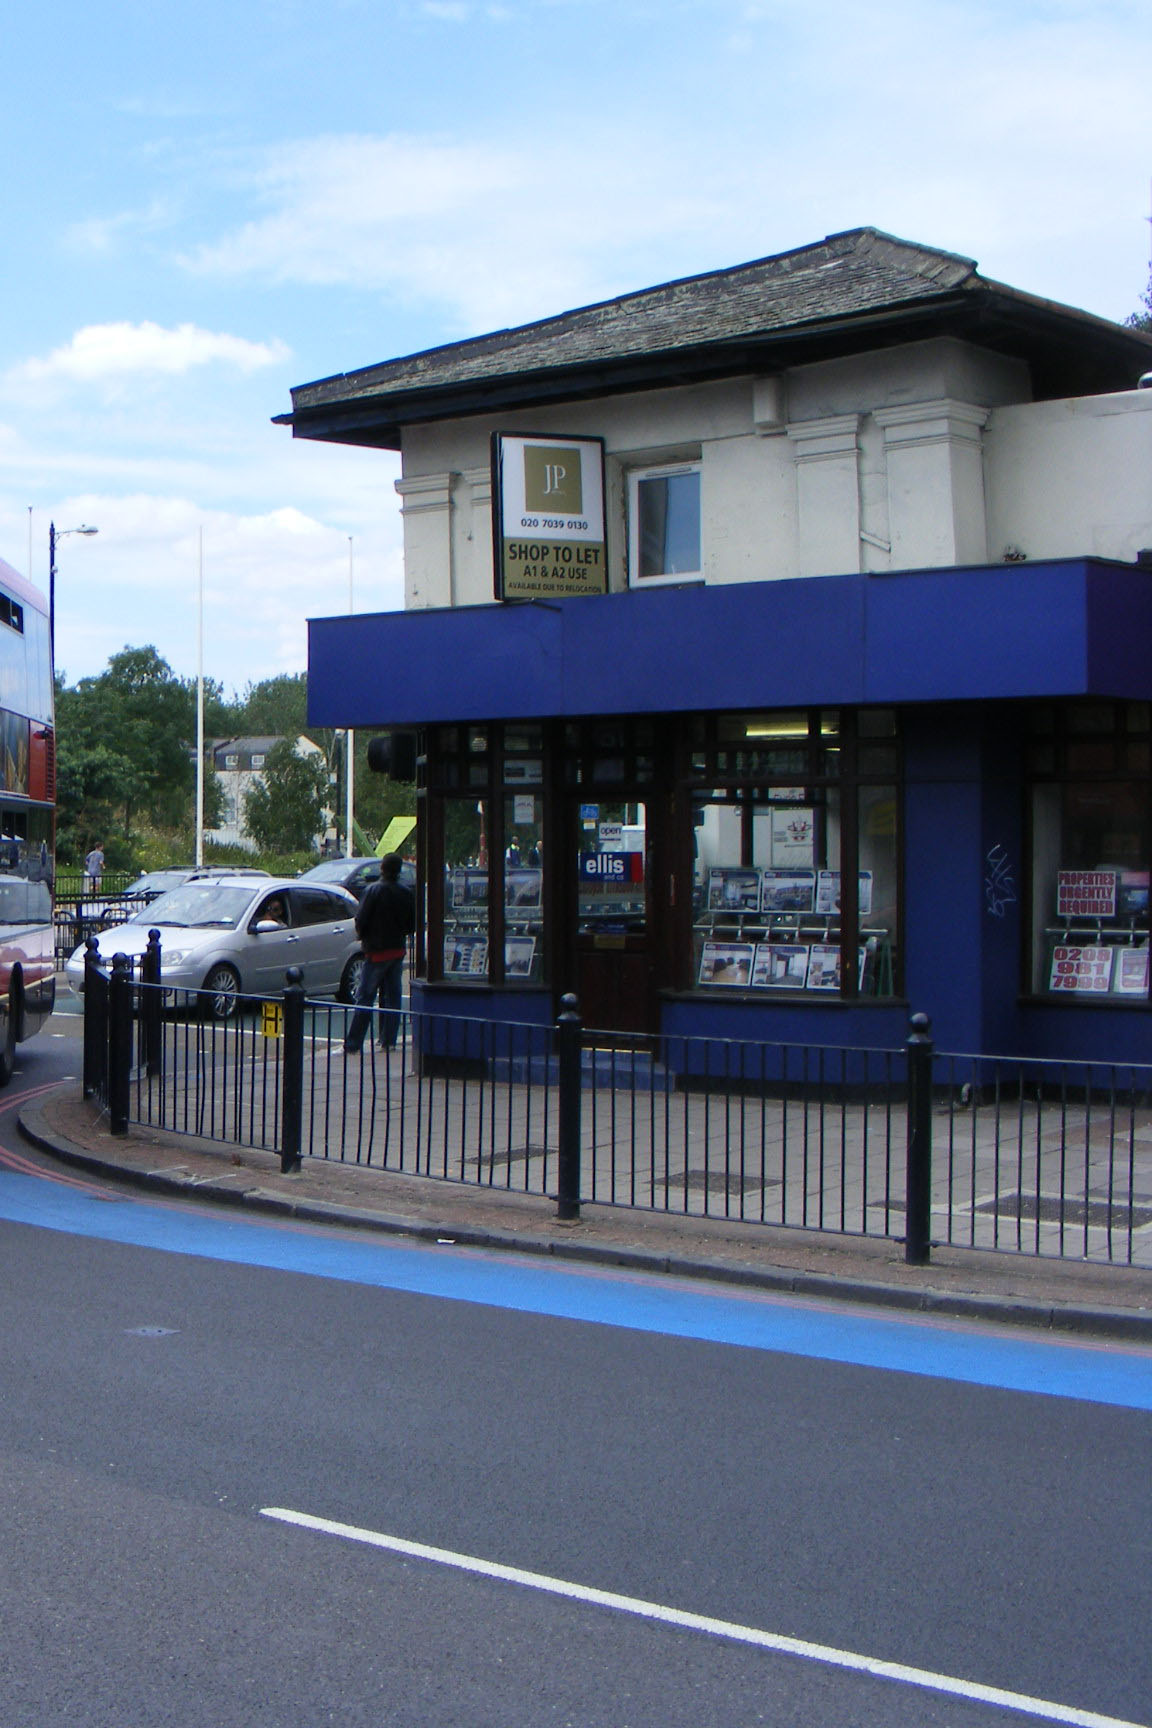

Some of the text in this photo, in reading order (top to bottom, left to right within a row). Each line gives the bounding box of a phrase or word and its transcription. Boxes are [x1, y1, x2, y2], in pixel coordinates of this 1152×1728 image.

[544, 464, 566, 494] JP
[520, 518, 588, 530] 020 7039 0130
[508, 543, 600, 565] SHOP TO LET
[523, 565, 588, 580] A1 & A2 USE
[508, 582, 541, 590] AVAILABLE
[542, 583, 556, 591] DUE
[556, 584, 565, 592] TO
[600, 827, 621, 836] open
[585, 854, 625, 874] ellis
[1058, 872, 1115, 886] PROPERTIES
[1059, 886, 1113, 900] URGENTLY
[1059, 900, 1113, 915] REQUIRED
[1054, 948, 1111, 961] 0208
[1057, 961, 1105, 975] 981
